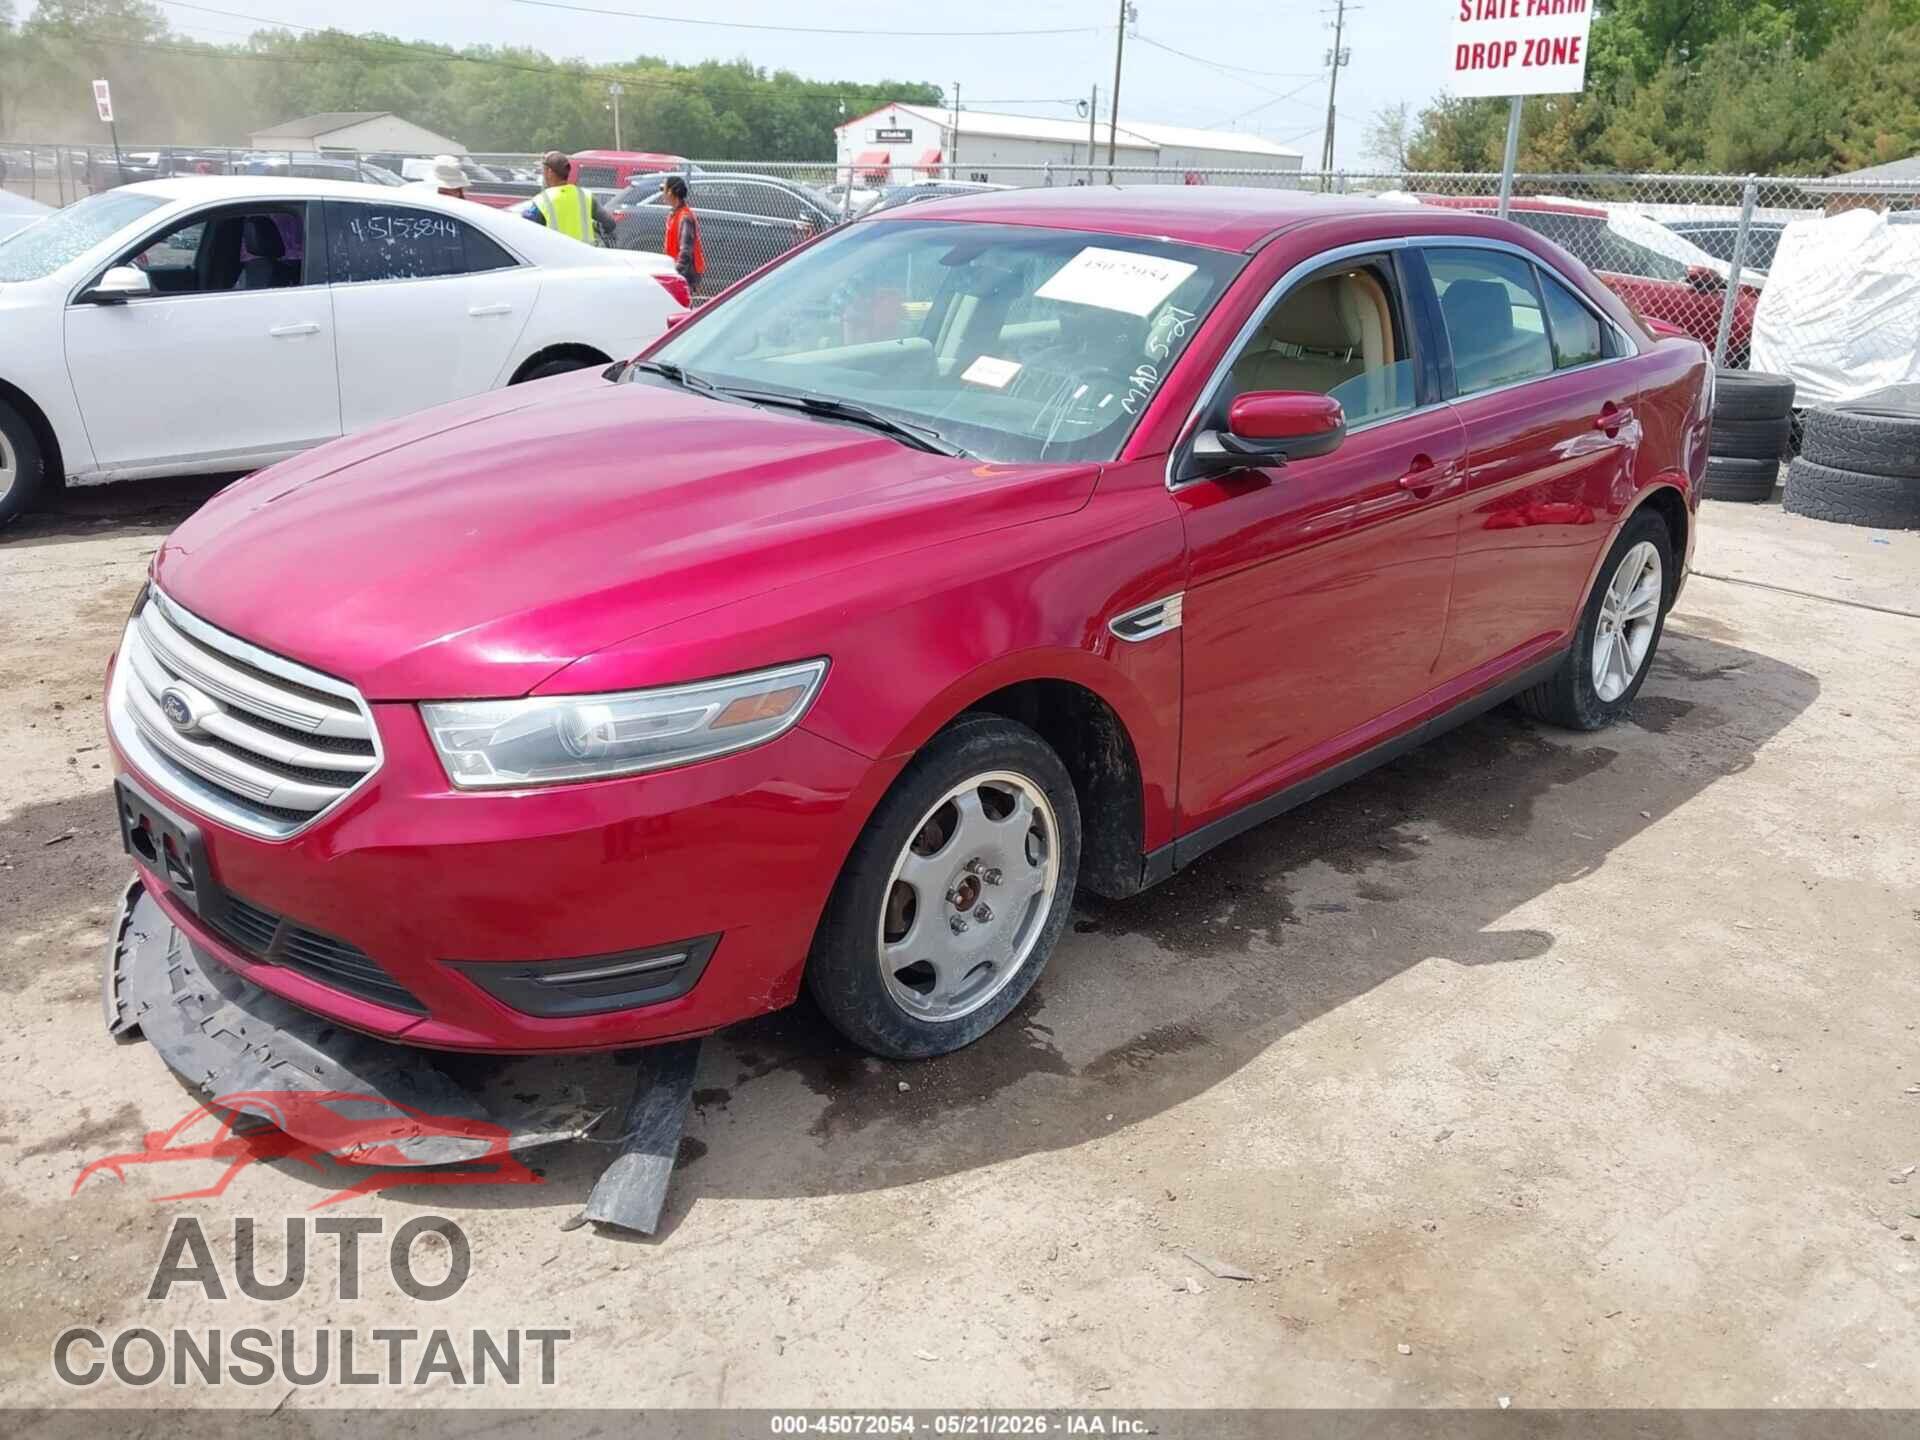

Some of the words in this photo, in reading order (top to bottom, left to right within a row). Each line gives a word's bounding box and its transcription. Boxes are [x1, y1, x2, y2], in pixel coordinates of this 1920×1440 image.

[1460, 0, 1520, 22] STATE
[1526, 0, 1586, 16] FARM
[1455, 41, 1517, 71] DROP
[1522, 36, 1581, 67] ZONE
[1121, 364, 1161, 415] MAD
